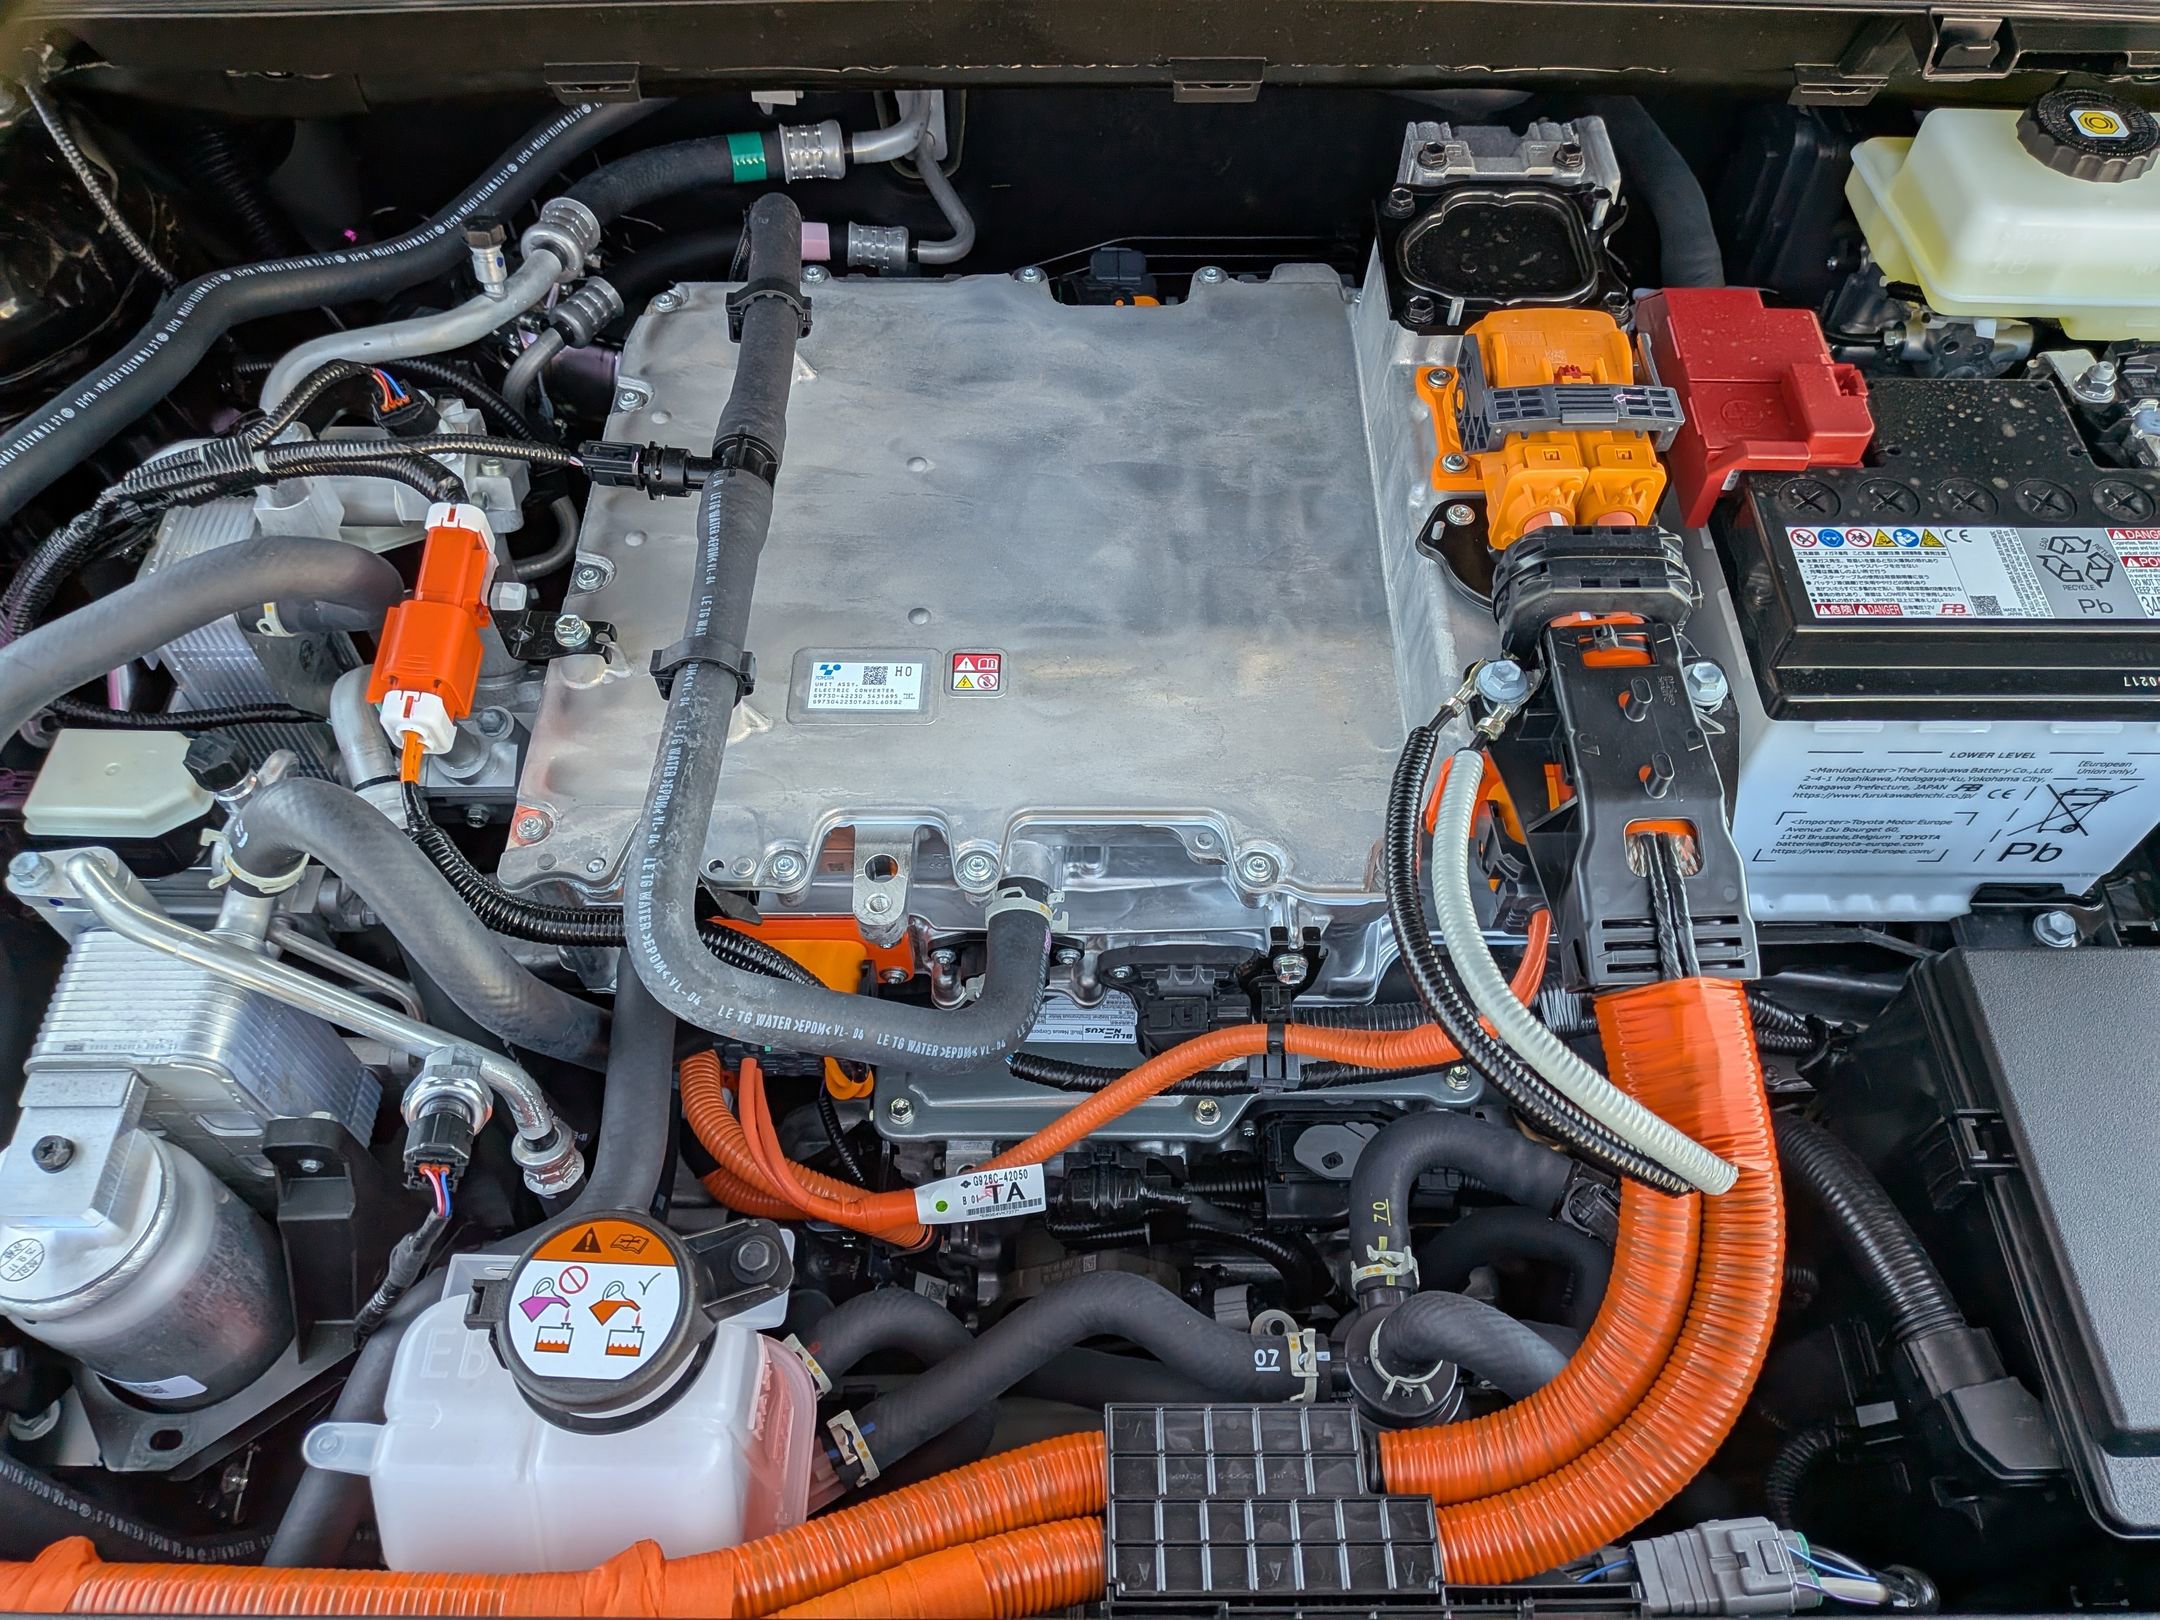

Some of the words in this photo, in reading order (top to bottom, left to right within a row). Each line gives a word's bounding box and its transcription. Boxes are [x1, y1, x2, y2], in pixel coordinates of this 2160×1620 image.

[701, 596, 712, 606] LE
[2078, 598, 2114, 614] Pb
[2142, 596, 2160, 616] 34
[1866, 605, 1901, 616] DANGER
[2123, 676, 2160, 687] 0217
[675, 720, 688, 731] LE
[664, 747, 681, 777] WATER
[1970, 767, 2012, 775] Battery
[1797, 784, 1851, 792] Kanagawa
[1853, 783, 1911, 791] Prefecture,
[1842, 826, 1883, 834] Bourget
[1917, 819, 1953, 827] Europe
[1775, 841, 1924, 849] batteries@toyota-europe.com
[1997, 842, 2065, 864] Pb
[642, 858, 656, 871] LE
[639, 891, 652, 931] WATER
[717, 1005, 734, 1019] LE
[737, 1010, 753, 1024] TG
[756, 1013, 792, 1031] WATER
[877, 1033, 889, 1046] LE
[892, 1036, 904, 1050] TG
[907, 1039, 938, 1057] WATER
[984, 1182, 1026, 1205] TA
[1372, 1201, 1388, 1223] 70
[1254, 1348, 1280, 1367] 07
